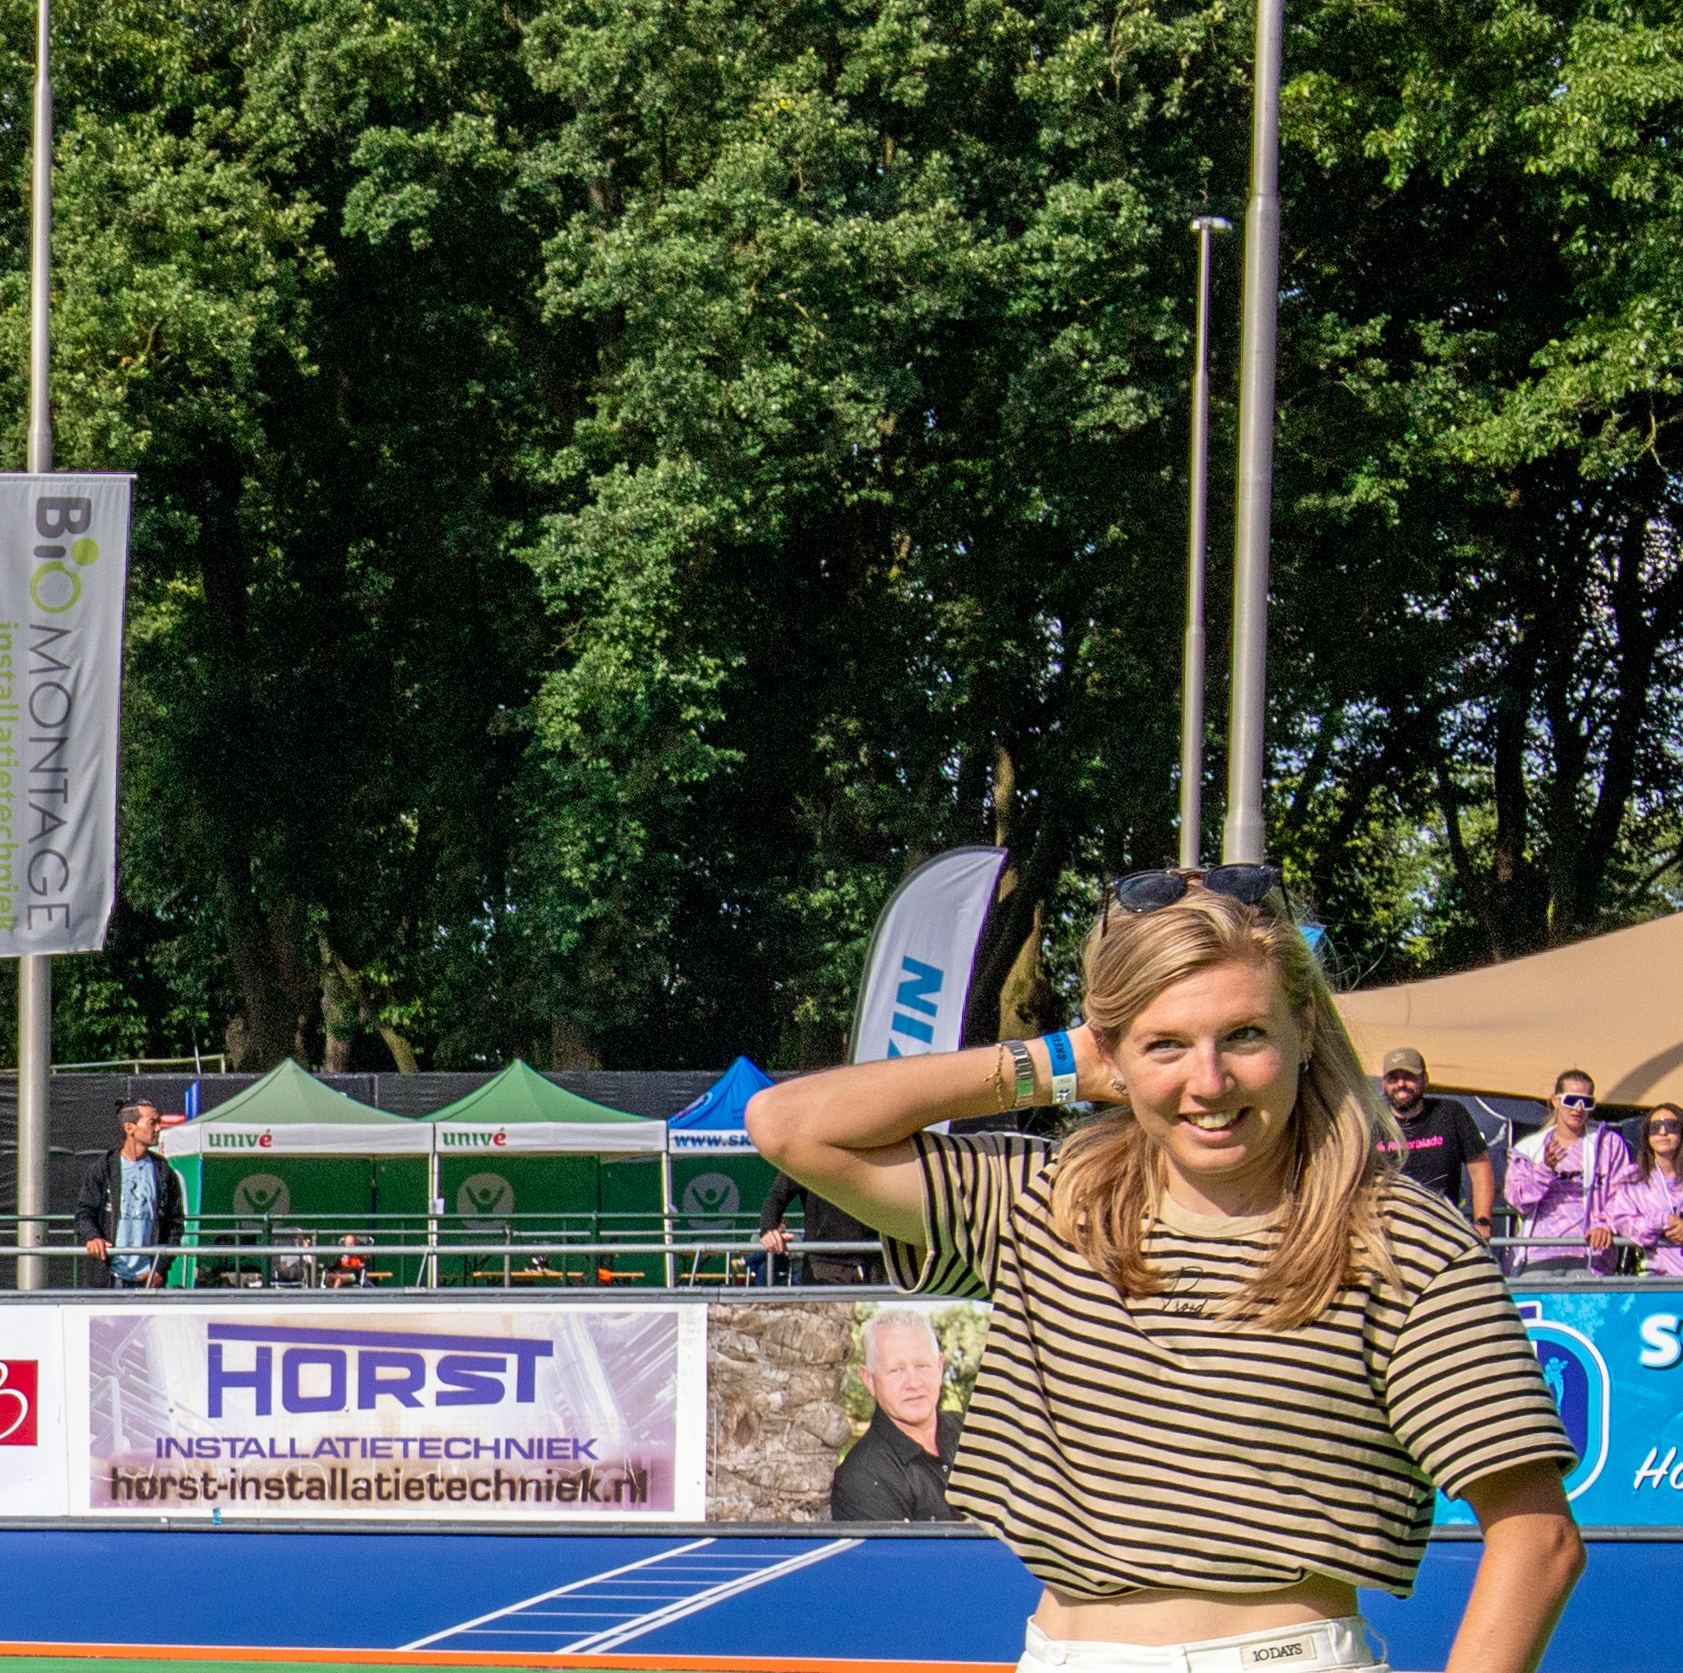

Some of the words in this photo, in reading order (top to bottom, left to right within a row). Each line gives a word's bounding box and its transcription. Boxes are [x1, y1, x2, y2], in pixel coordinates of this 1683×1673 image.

[887, 955, 944, 1059] IN
[208, 1128, 272, 1148] univé
[442, 1127, 506, 1147] univé
[207, 1323, 554, 1419] HORST
[155, 1437, 599, 1461] INSTALLATIETECHNIEK
[110, 1466, 648, 1505] horst-installatietechniek.nl
